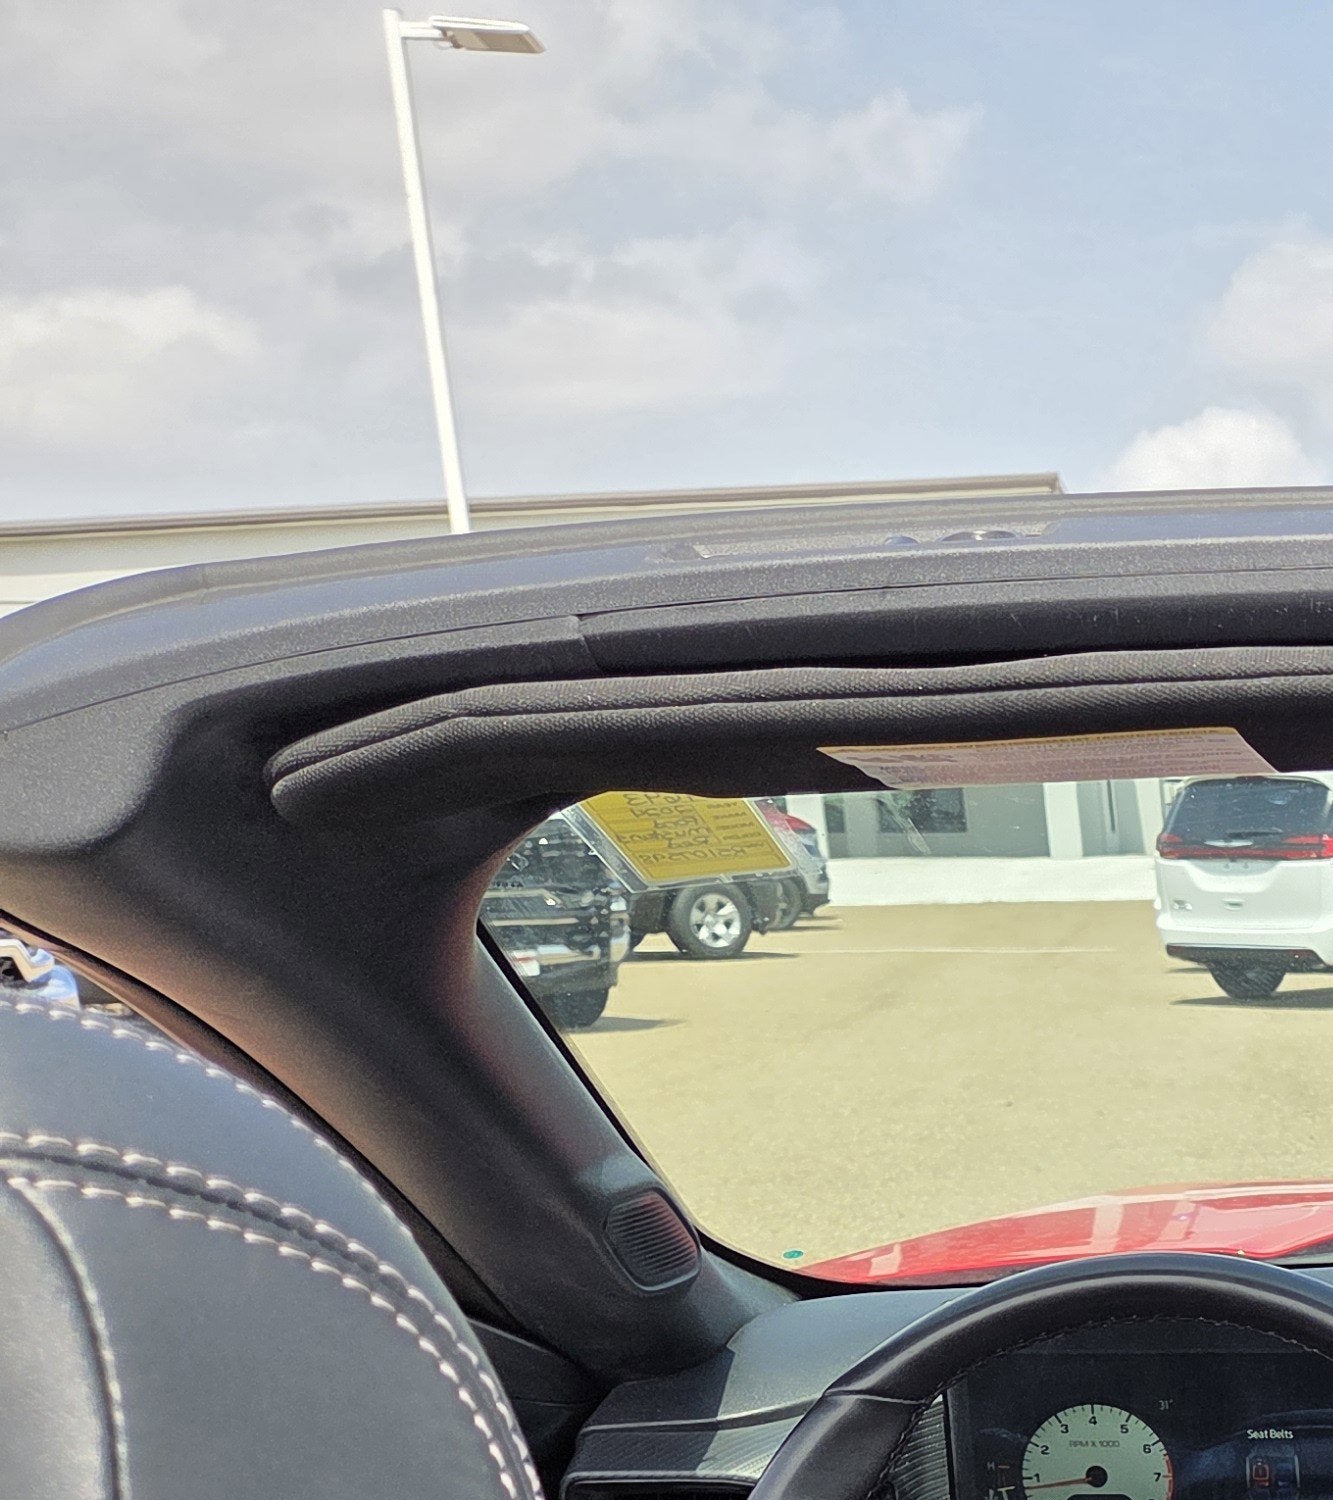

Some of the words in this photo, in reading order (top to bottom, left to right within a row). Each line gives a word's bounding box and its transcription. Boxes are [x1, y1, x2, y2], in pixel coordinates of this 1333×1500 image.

[1088, 1415, 1099, 1426] 4
[1060, 1424, 1070, 1435] 3
[1119, 1424, 1130, 1435] 5
[1247, 1429, 1268, 1440] Seat
[1269, 1430, 1294, 1440] Belts
[1069, 1440, 1090, 1448] RPM
[1098, 1440, 1120, 1448] 1000
[1142, 1444, 1152, 1455] 6
[1040, 1445, 1051, 1455] 2
[1033, 1473, 1041, 1483] 1
[1153, 1472, 1162, 1482] 7
